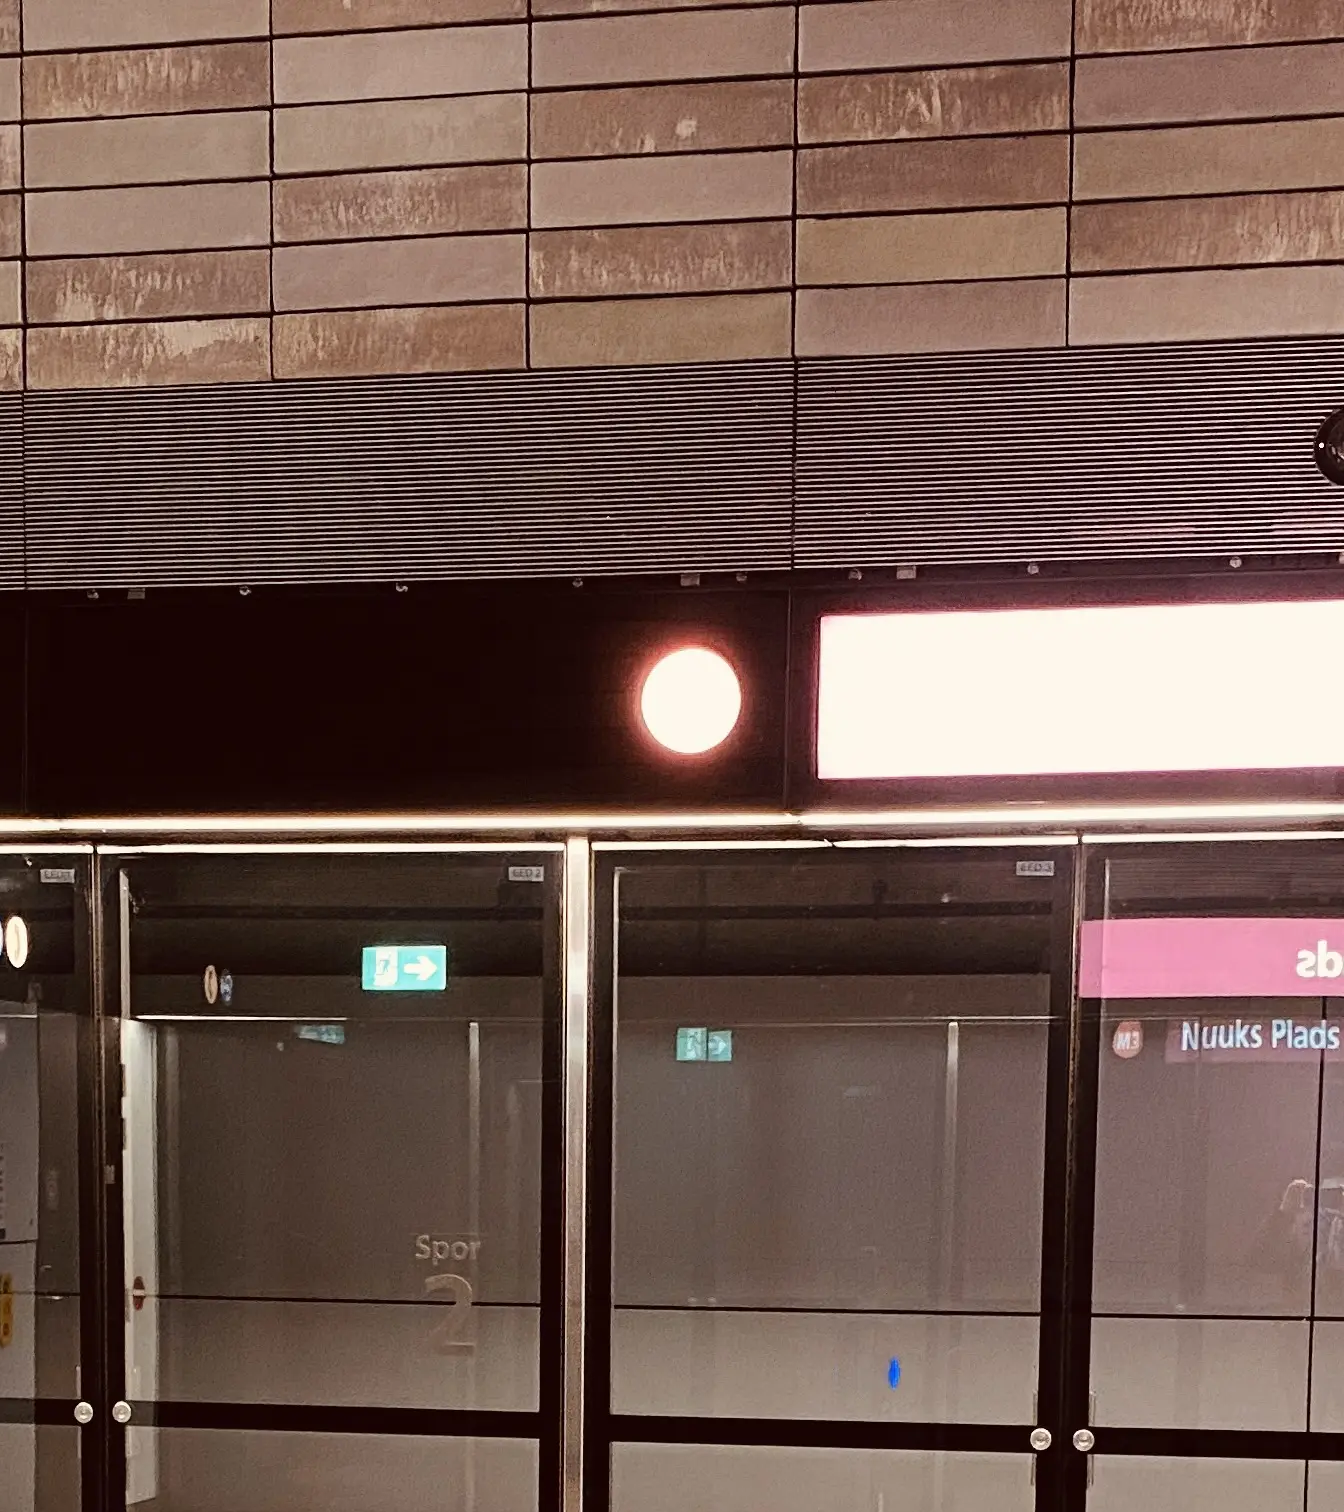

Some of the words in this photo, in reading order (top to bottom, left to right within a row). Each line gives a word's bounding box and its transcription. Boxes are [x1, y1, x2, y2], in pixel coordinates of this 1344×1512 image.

[1116, 1031, 1140, 1050] M3
[1181, 1019, 1263, 1051] Nuuks
[1271, 1018, 1341, 1050] Plads
[415, 1234, 481, 1266] Spor
[421, 1273, 474, 1356] 2
